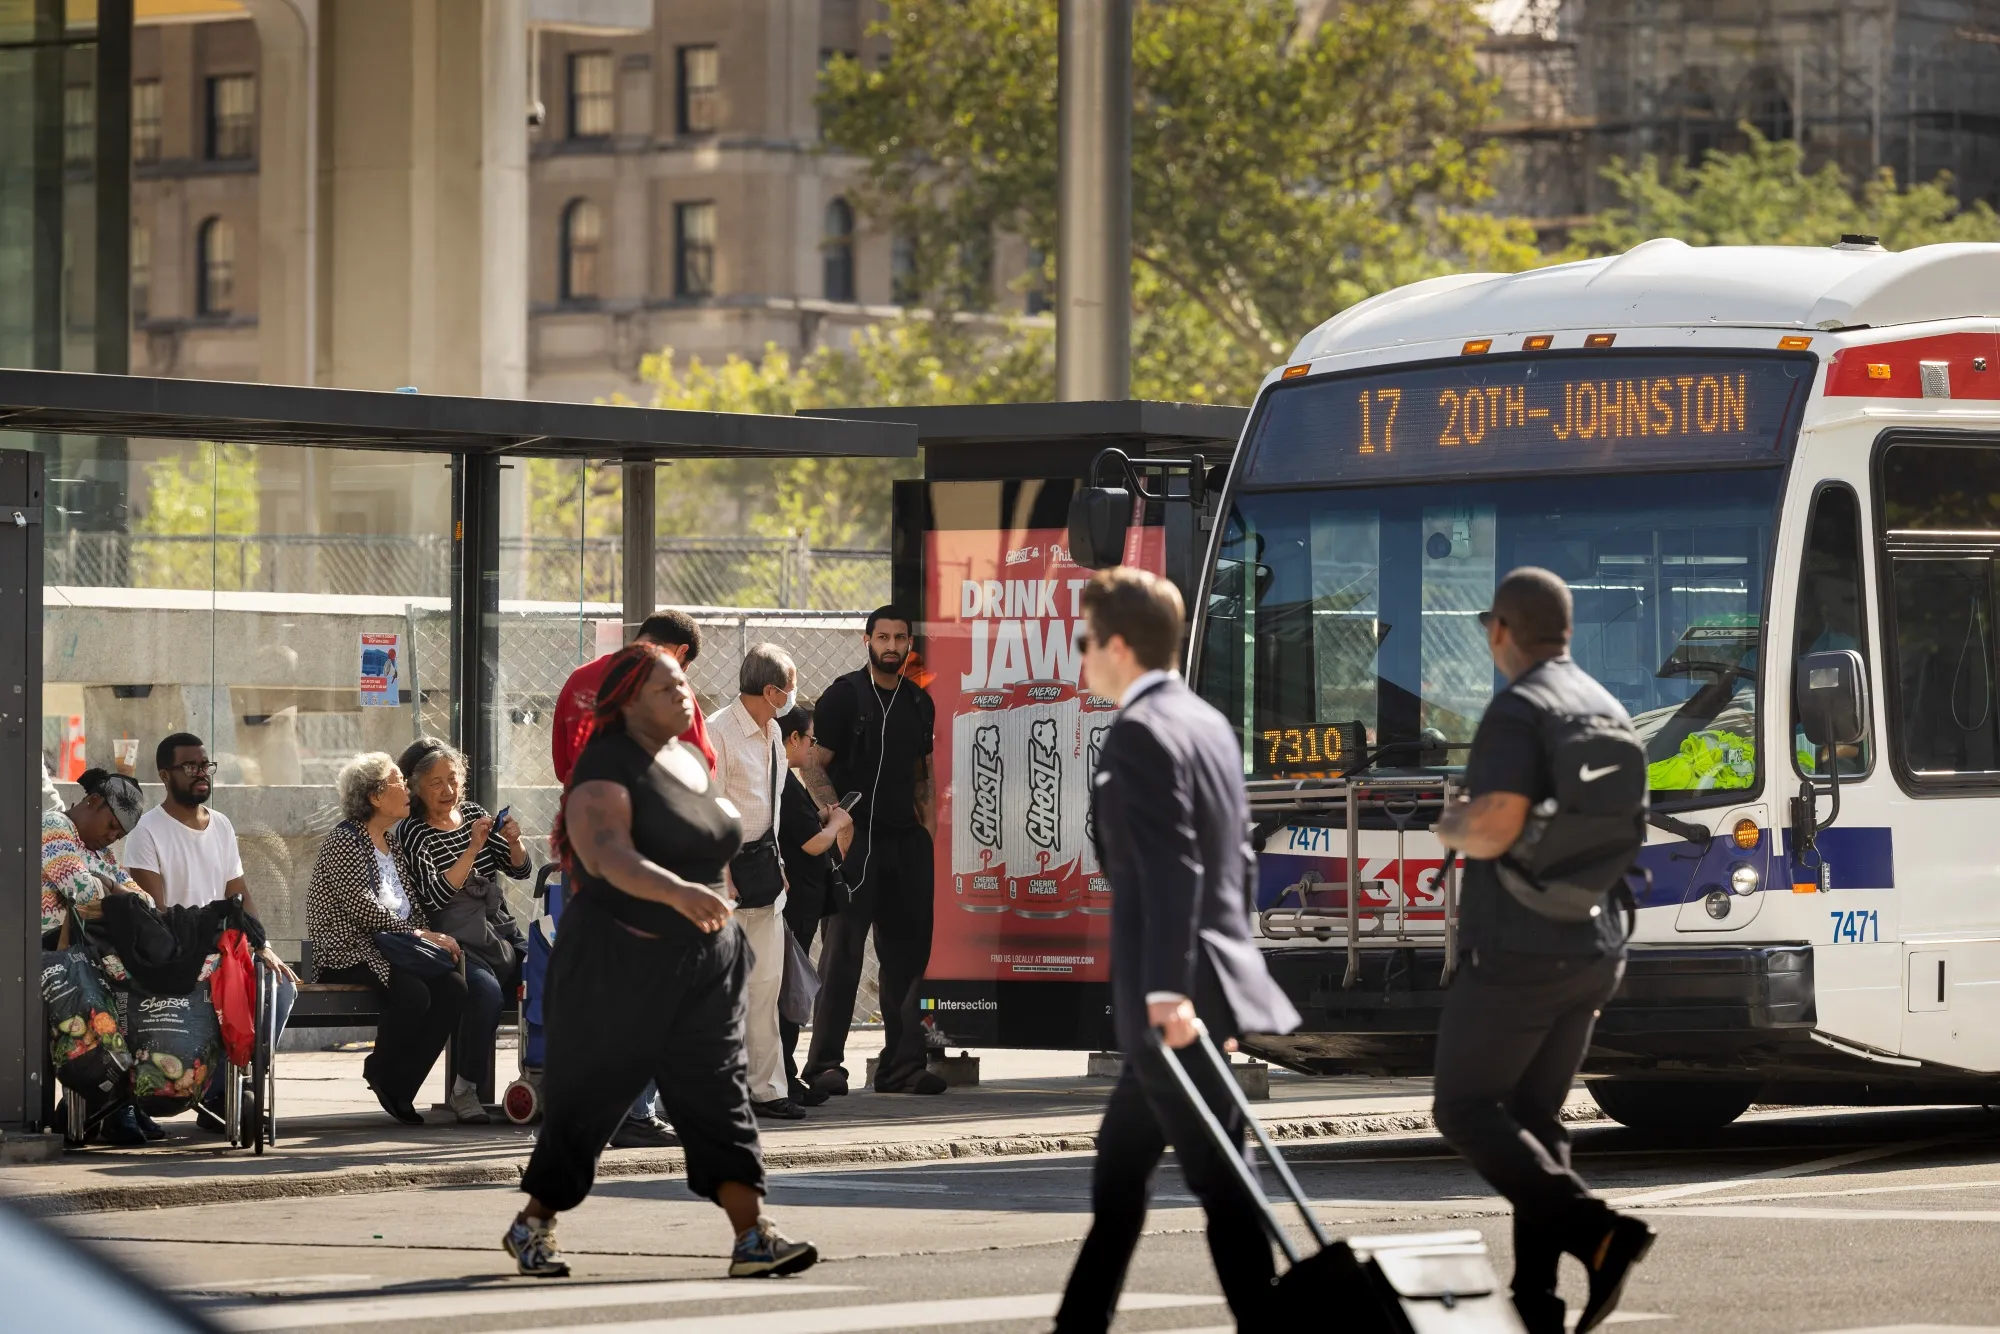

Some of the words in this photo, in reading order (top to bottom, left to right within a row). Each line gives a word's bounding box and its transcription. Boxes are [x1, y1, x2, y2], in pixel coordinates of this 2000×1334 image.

[1359, 389, 1401, 453] 17
[1440, 374, 1745, 446] 20TH-JOHNSTON
[1005, 546, 1032, 566] GHOST
[1050, 544, 1074, 562] Phil
[961, 580, 1059, 617] DRINK
[1067, 579, 1093, 618] T
[961, 619, 1090, 691] JAW
[972, 695, 1003, 705] ENERGY
[1028, 686, 1062, 697] ENERGY
[1264, 727, 1342, 763] 7310
[970, 744, 1003, 850] GHOST
[1026, 738, 1062, 852] GHOST
[1287, 825, 1330, 852] 7471
[1030, 880, 1057, 888] CHERRY
[1088, 884, 1113, 892] LIMEAD
[1830, 910, 1879, 943] 7471
[991, 954, 1003, 962] FIND
[1004, 955, 1011, 963] US
[1012, 955, 1034, 963] LOCALLY
[1035, 955, 1042, 963] AT
[1043, 956, 1095, 965] DRINKGHOST.COM
[138, 997, 190, 1013] ShopRite
[938, 999, 998, 1010] Intersection
